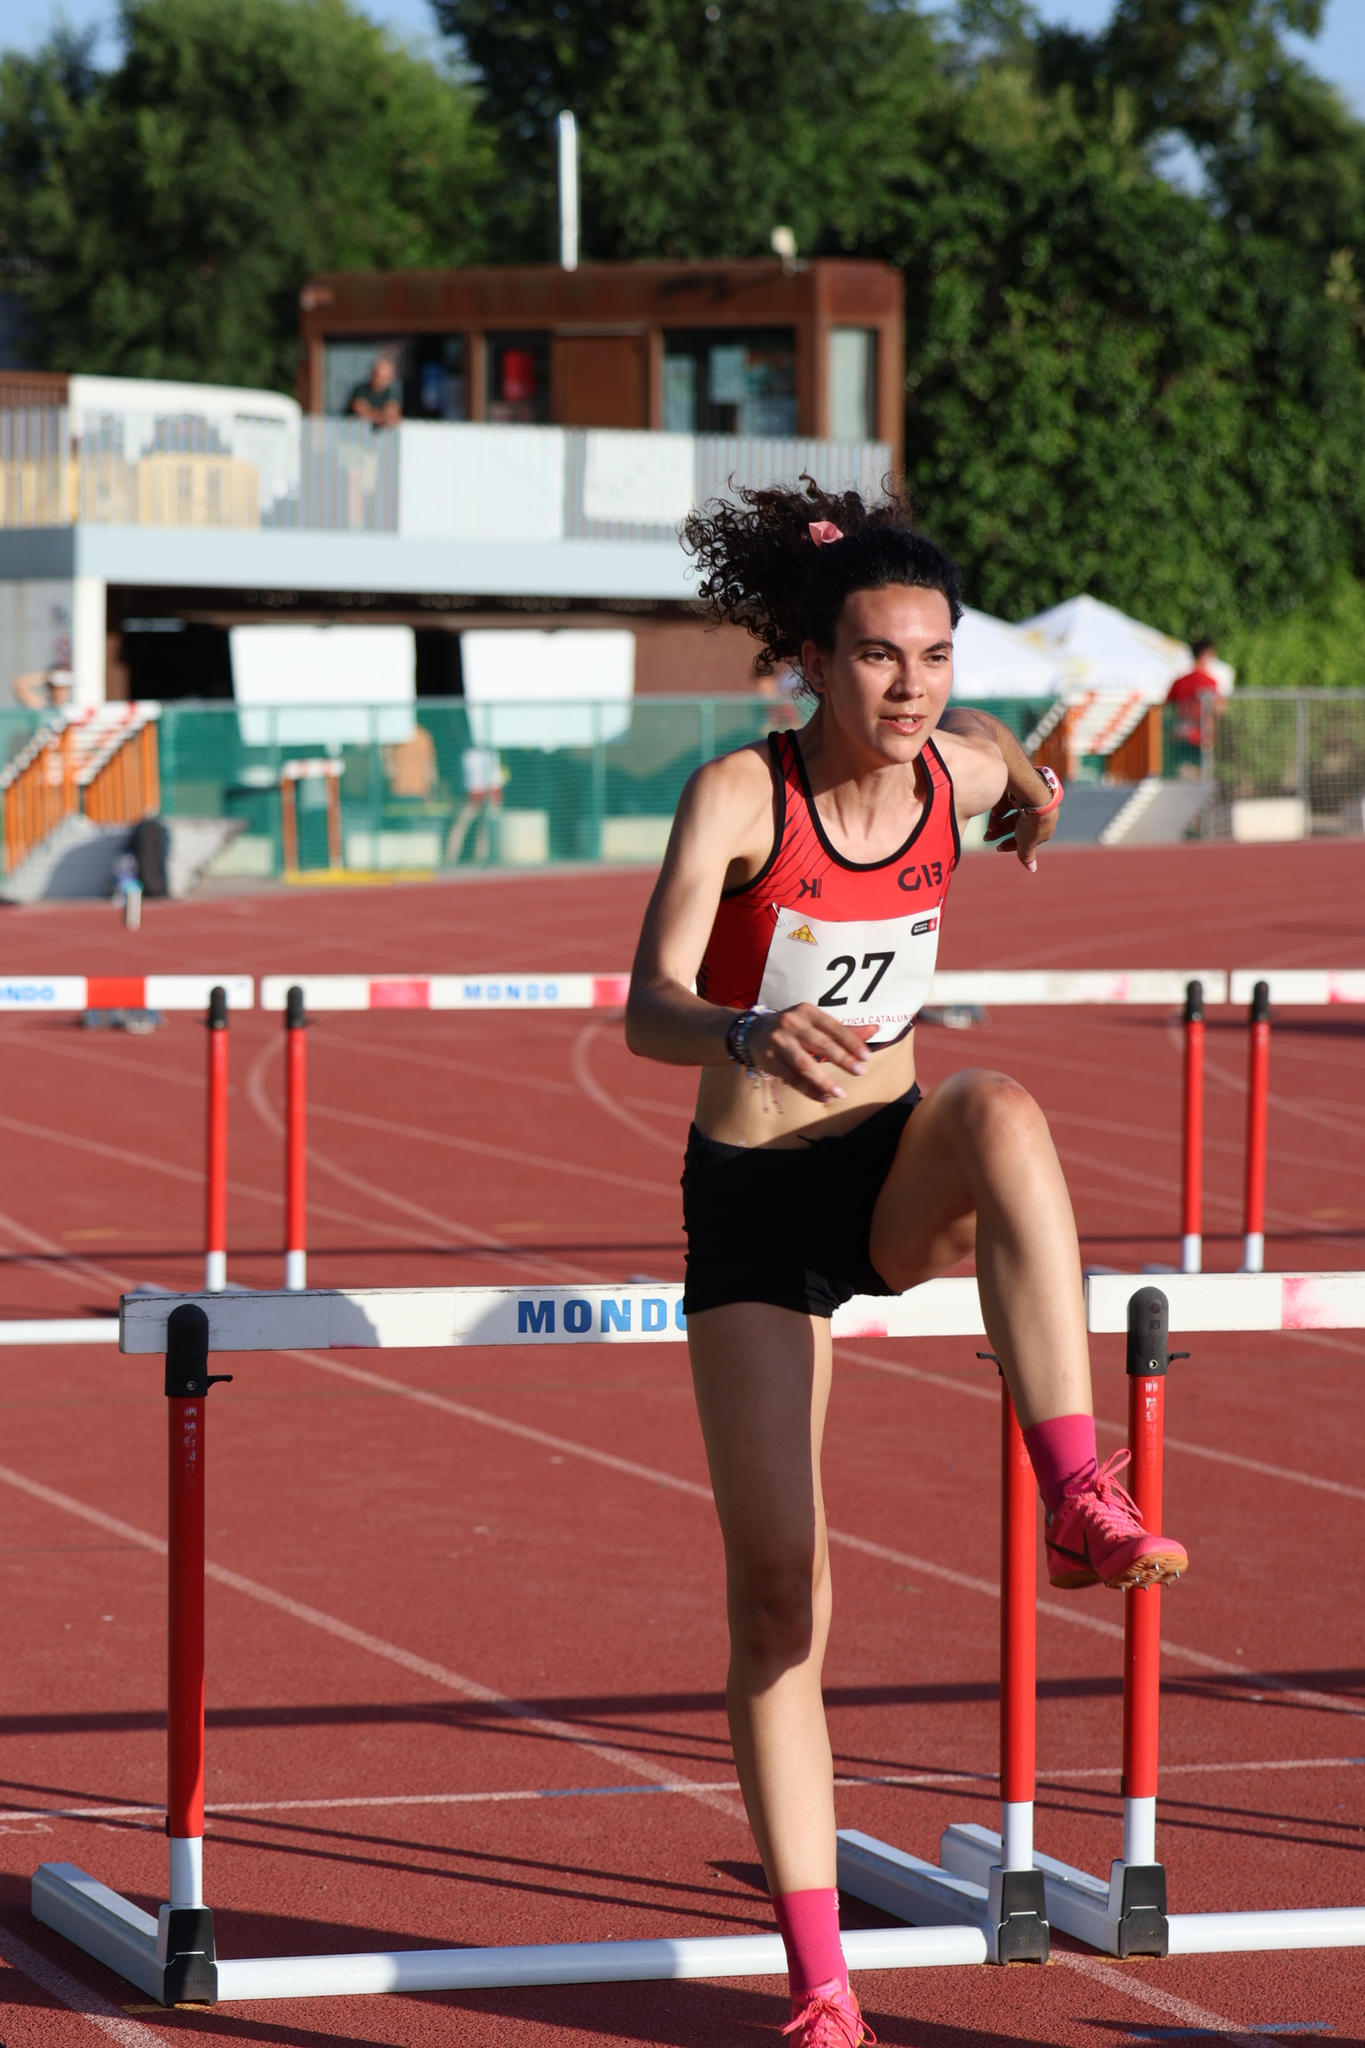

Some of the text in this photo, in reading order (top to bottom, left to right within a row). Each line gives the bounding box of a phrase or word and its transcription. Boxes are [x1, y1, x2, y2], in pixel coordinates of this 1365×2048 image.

[817, 951, 895, 1007] 27
[0, 984, 55, 1001] NDO
[464, 983, 559, 1000] MONDO
[868, 1013, 912, 1024] CATALUN
